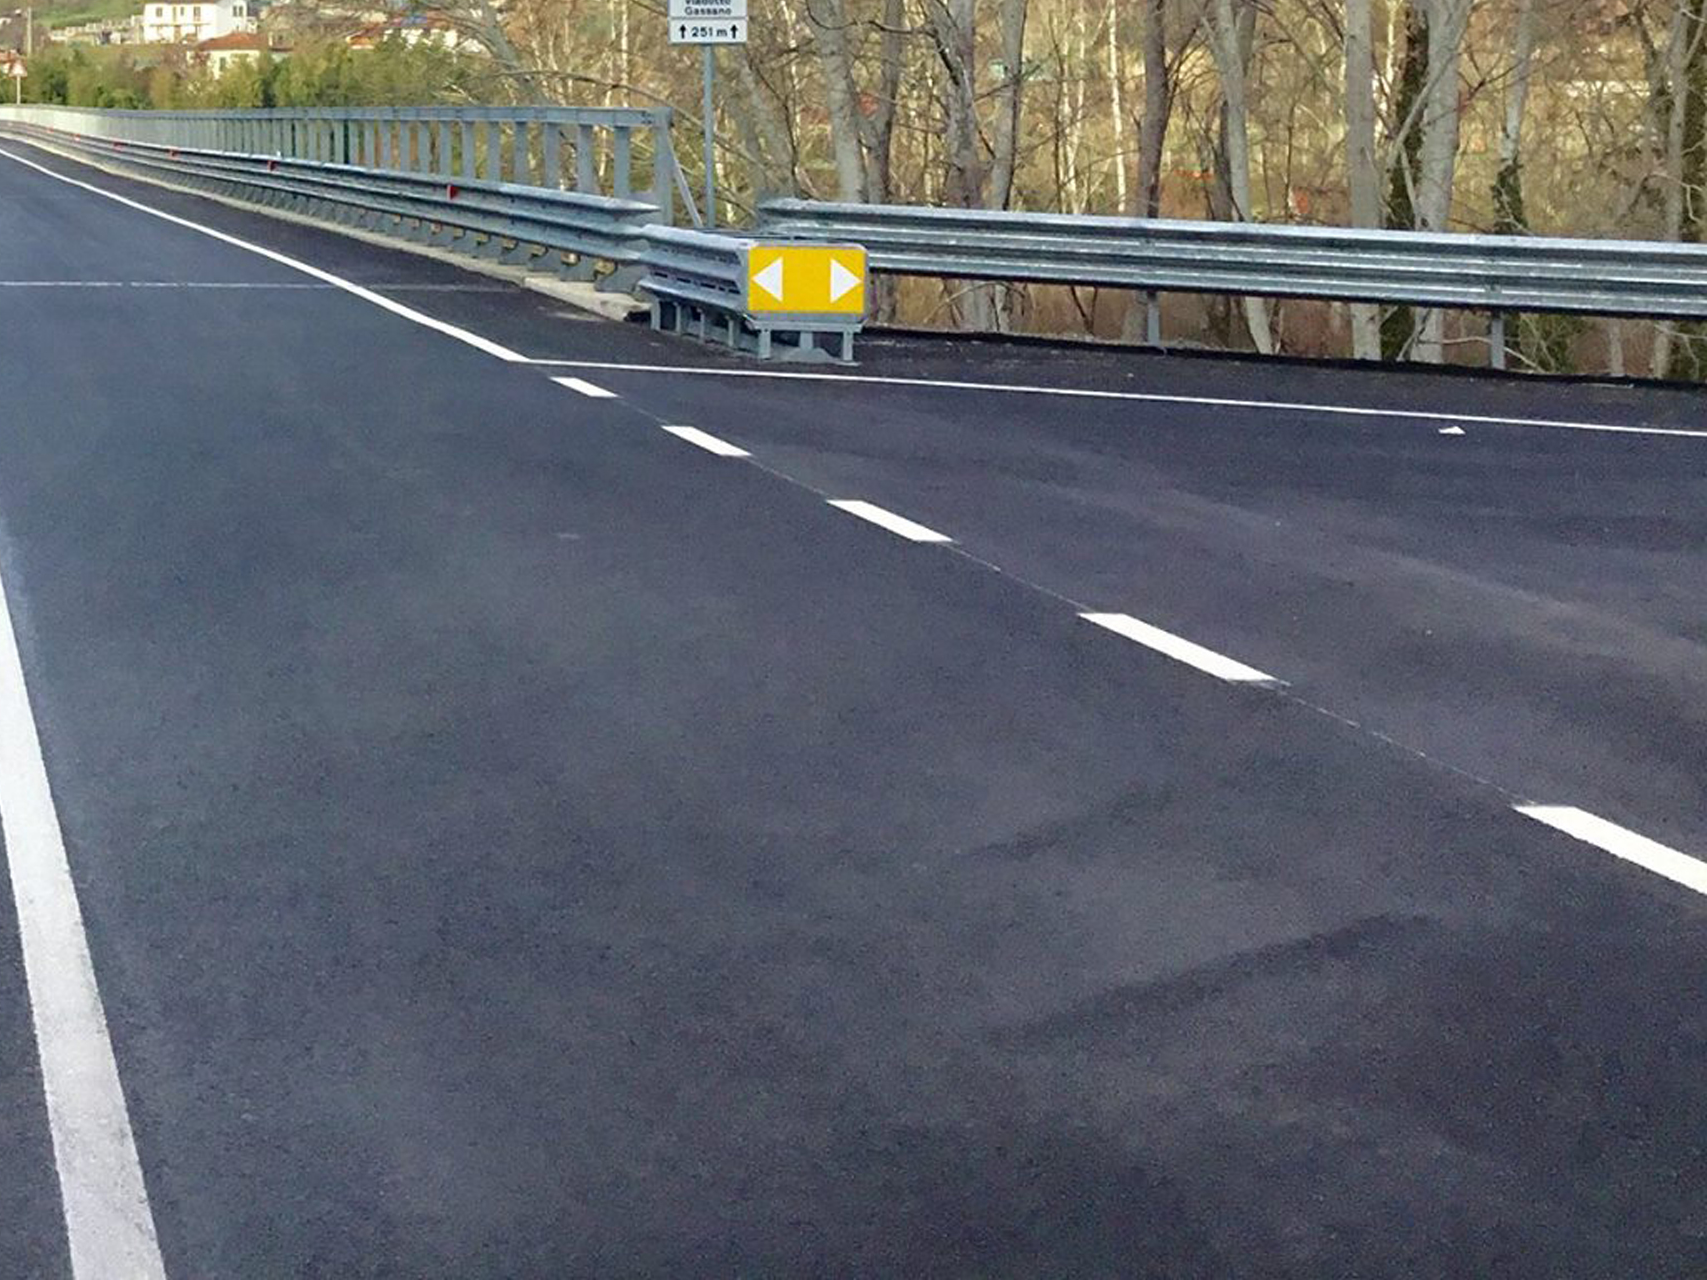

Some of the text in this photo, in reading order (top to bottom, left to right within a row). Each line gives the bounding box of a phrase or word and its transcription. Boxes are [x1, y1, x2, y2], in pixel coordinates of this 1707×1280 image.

[684, 6, 732, 15] Gassano
[691, 26, 728, 37] 251 m
